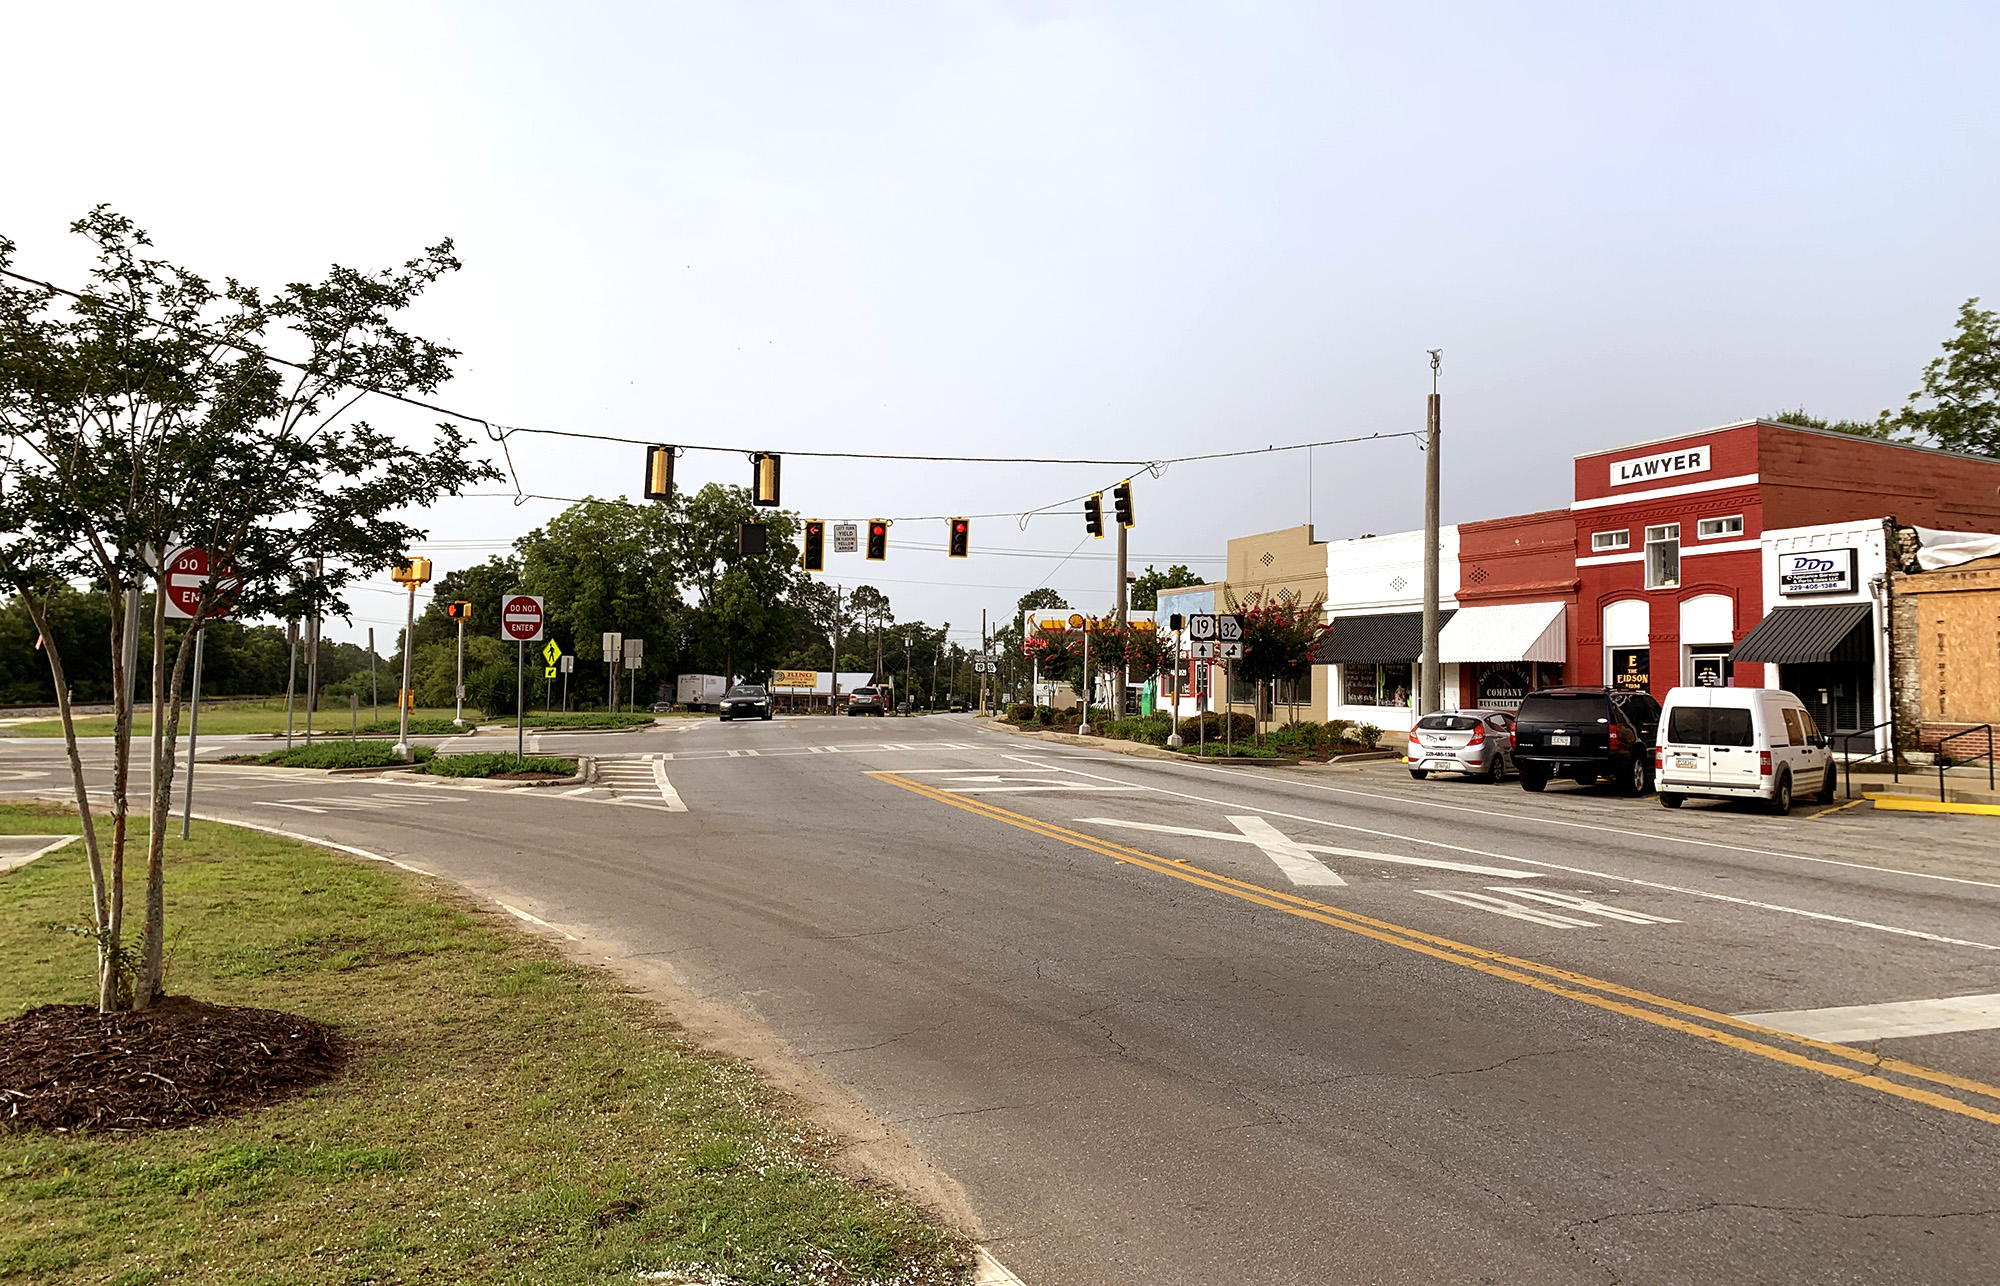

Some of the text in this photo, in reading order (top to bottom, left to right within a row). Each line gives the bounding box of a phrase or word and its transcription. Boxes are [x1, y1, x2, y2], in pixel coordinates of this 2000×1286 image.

[1621, 453, 1701, 480] LAWYER
[179, 559, 198, 571] DO
[1794, 557, 1834, 571] DDD
[510, 604, 537, 613] DO NOT
[511, 624, 535, 632] ENTER
[1196, 619, 1209, 634] 19
[1222, 623, 1237, 638] 32
[1617, 674, 1649, 684] EIDSON
[1486, 688, 1523, 697] COMPANY
